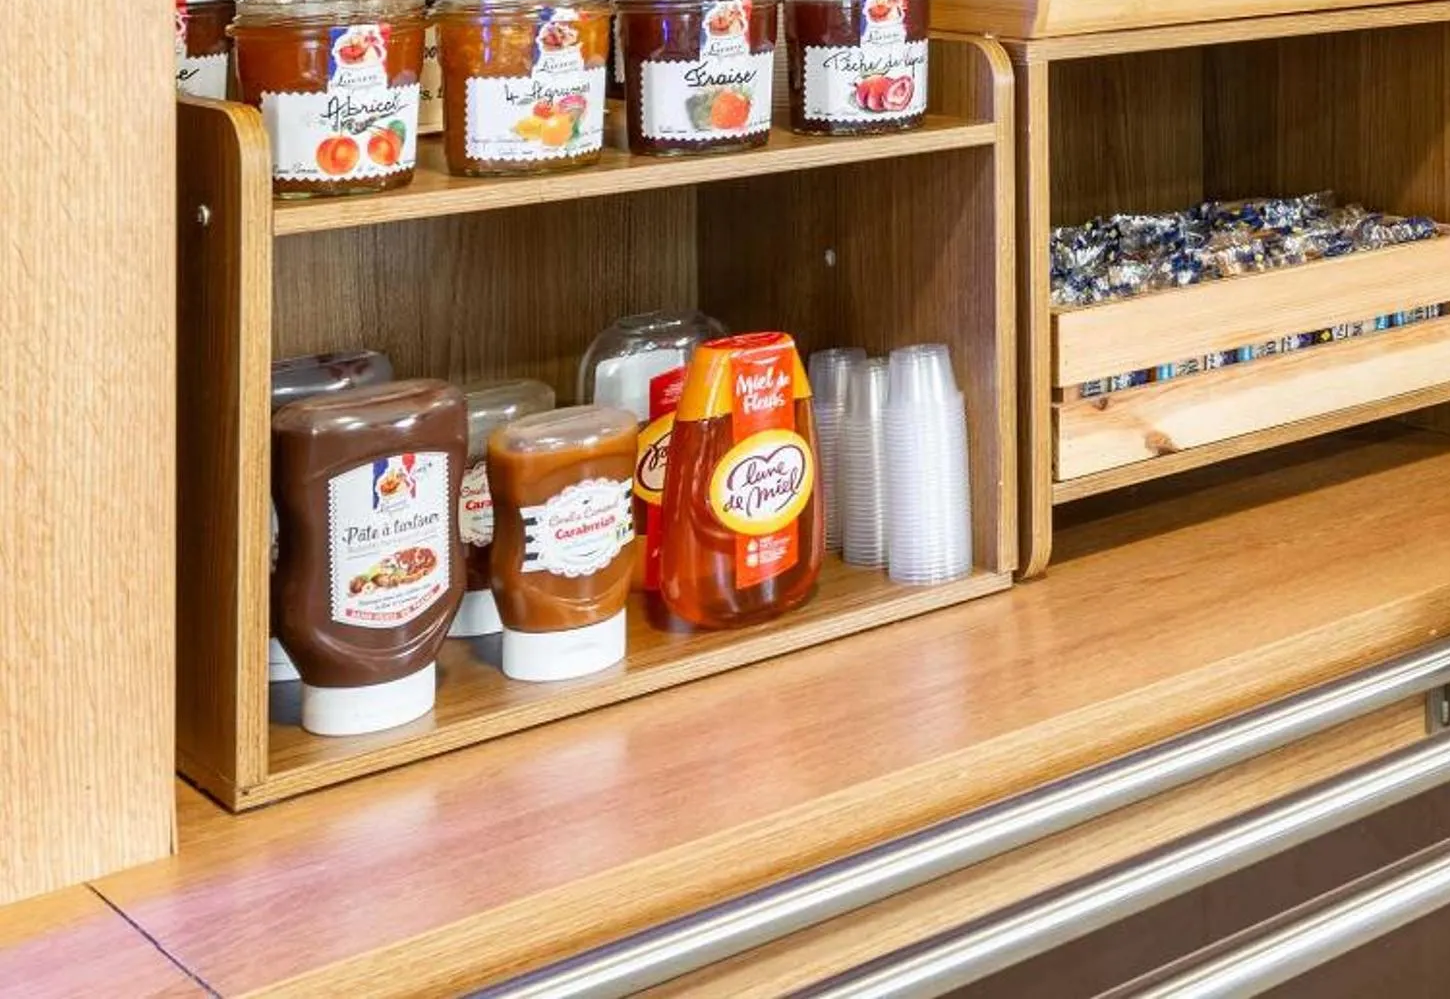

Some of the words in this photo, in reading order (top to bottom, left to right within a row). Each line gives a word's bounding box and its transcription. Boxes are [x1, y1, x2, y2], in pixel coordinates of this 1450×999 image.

[684, 61, 757, 87] Fraise
[320, 94, 407, 119] Abricot
[736, 368, 775, 394] Miel
